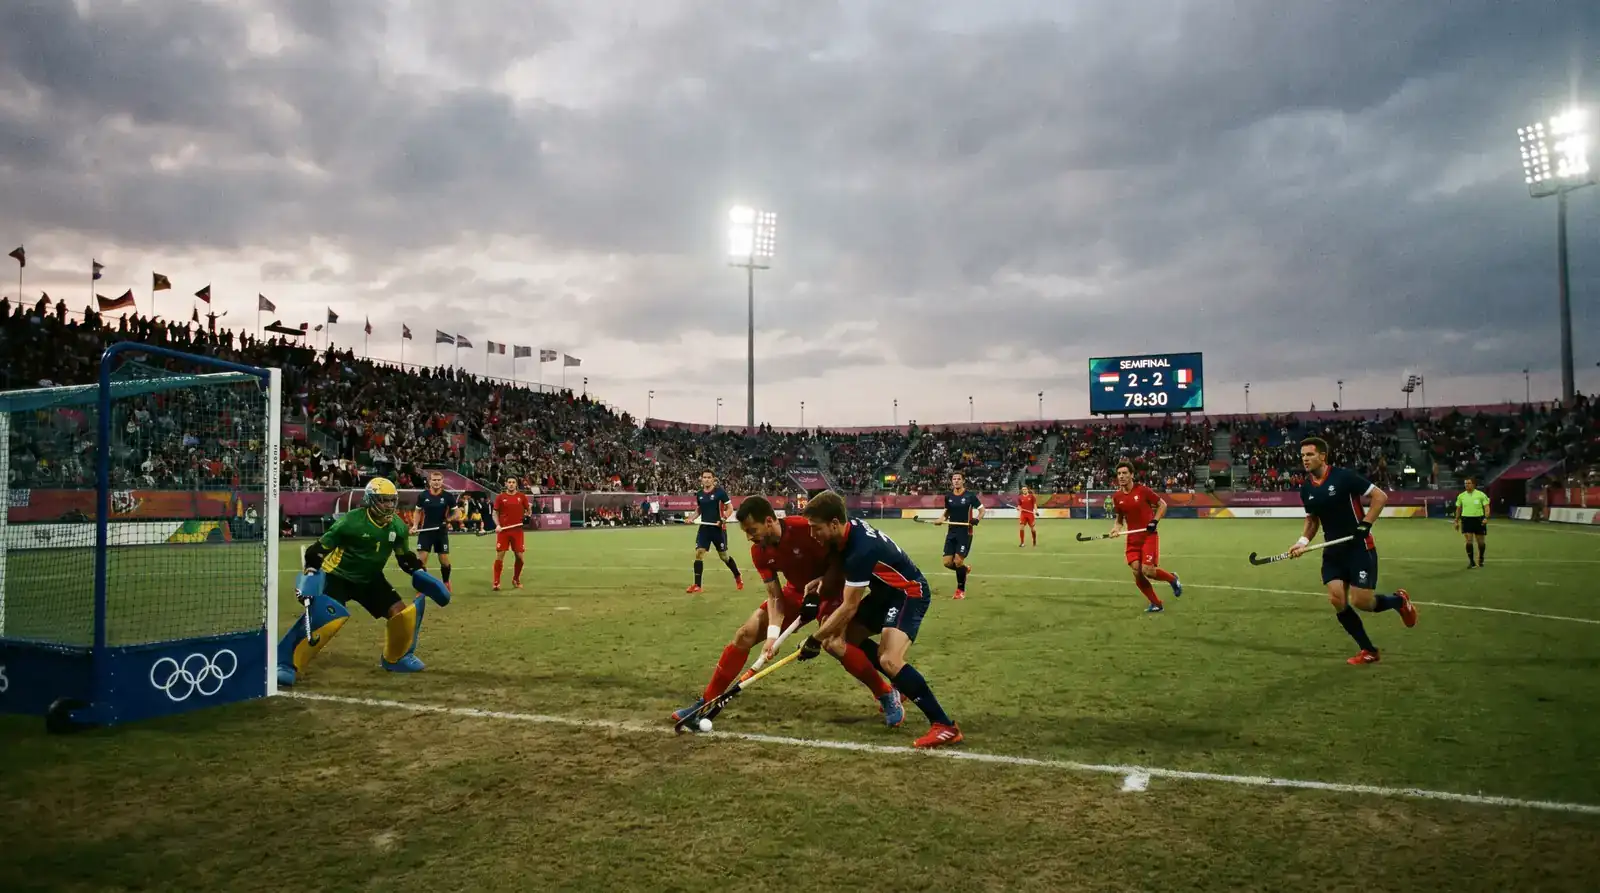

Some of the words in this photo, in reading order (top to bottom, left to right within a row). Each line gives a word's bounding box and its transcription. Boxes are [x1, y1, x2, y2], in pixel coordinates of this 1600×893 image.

[1119, 358, 1171, 370] SEMIFINAL
[1128, 373, 1138, 387] 2
[1152, 372, 1163, 386] 2
[1123, 392, 1168, 407] 78:30
